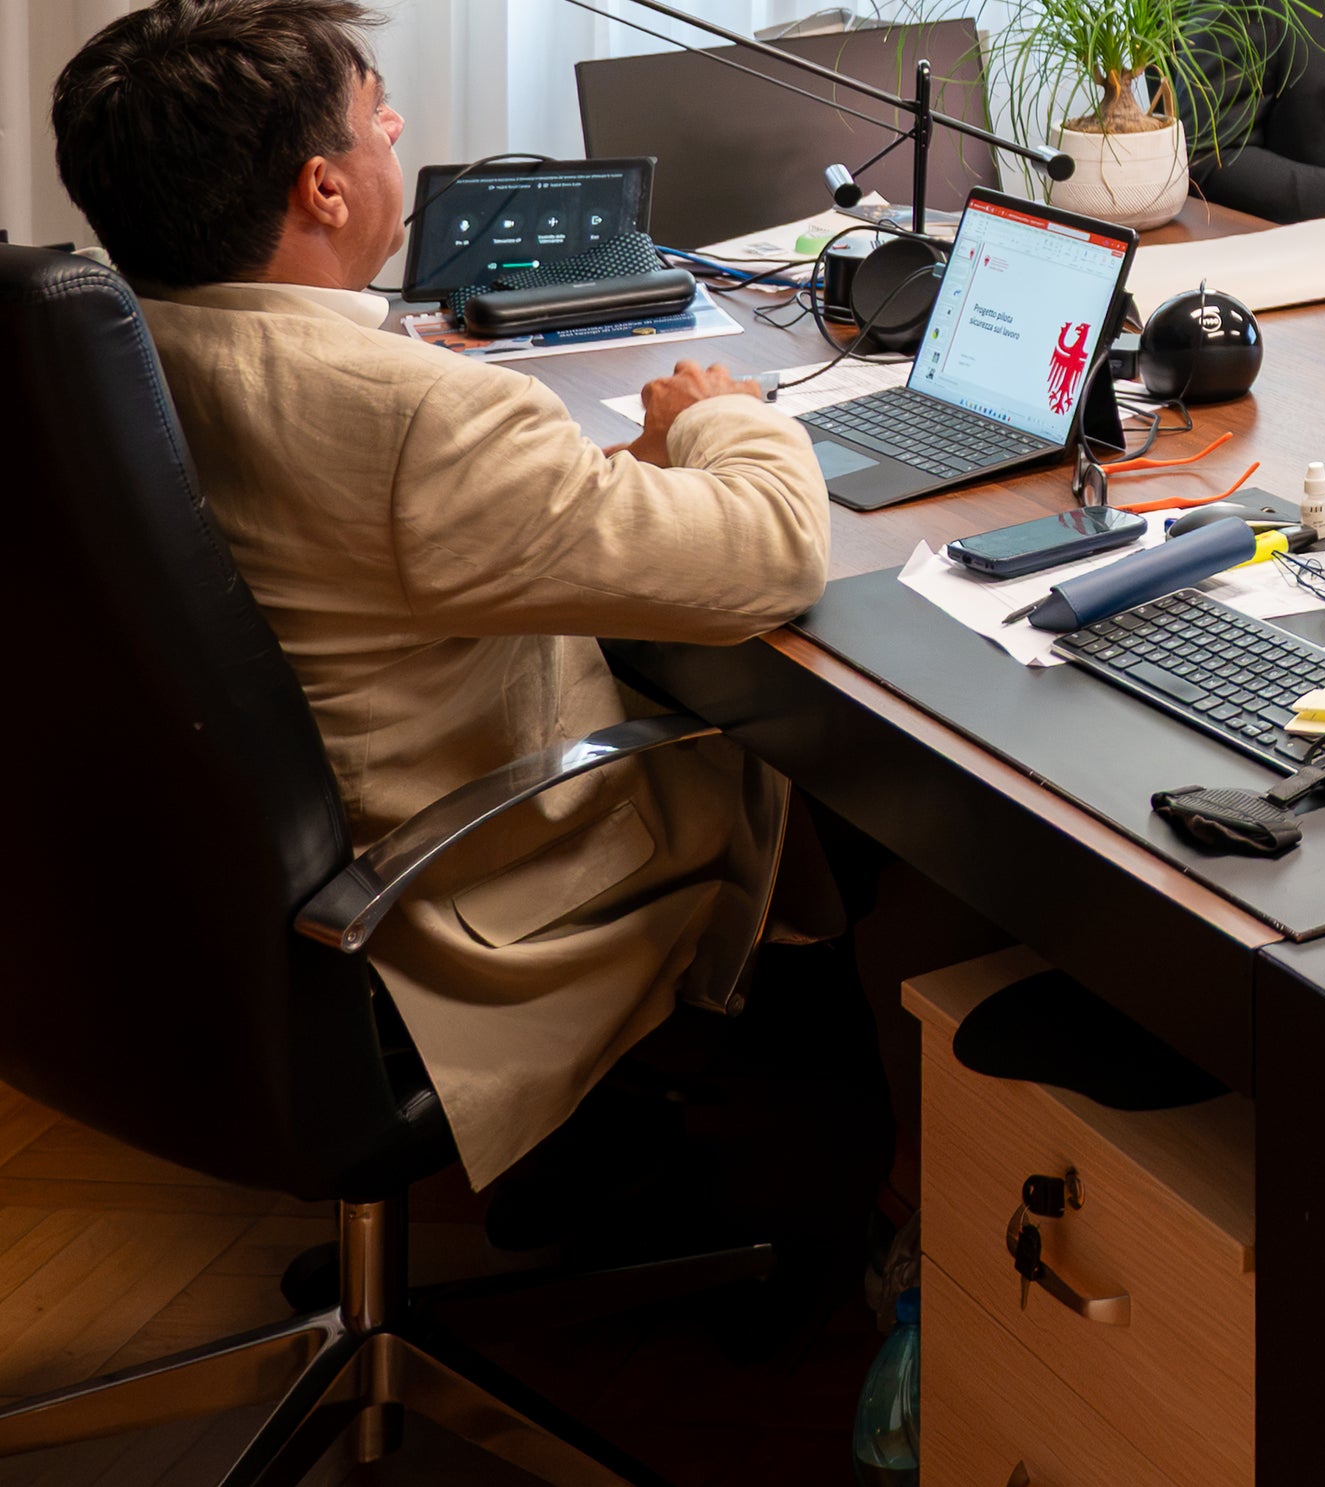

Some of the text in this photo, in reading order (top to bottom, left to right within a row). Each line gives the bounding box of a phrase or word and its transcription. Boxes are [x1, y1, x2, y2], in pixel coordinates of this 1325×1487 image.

[973, 303, 1013, 323] Progetto pilota
[969, 316, 993, 331] sicurezza
[1002, 327, 1020, 340] lavoro
